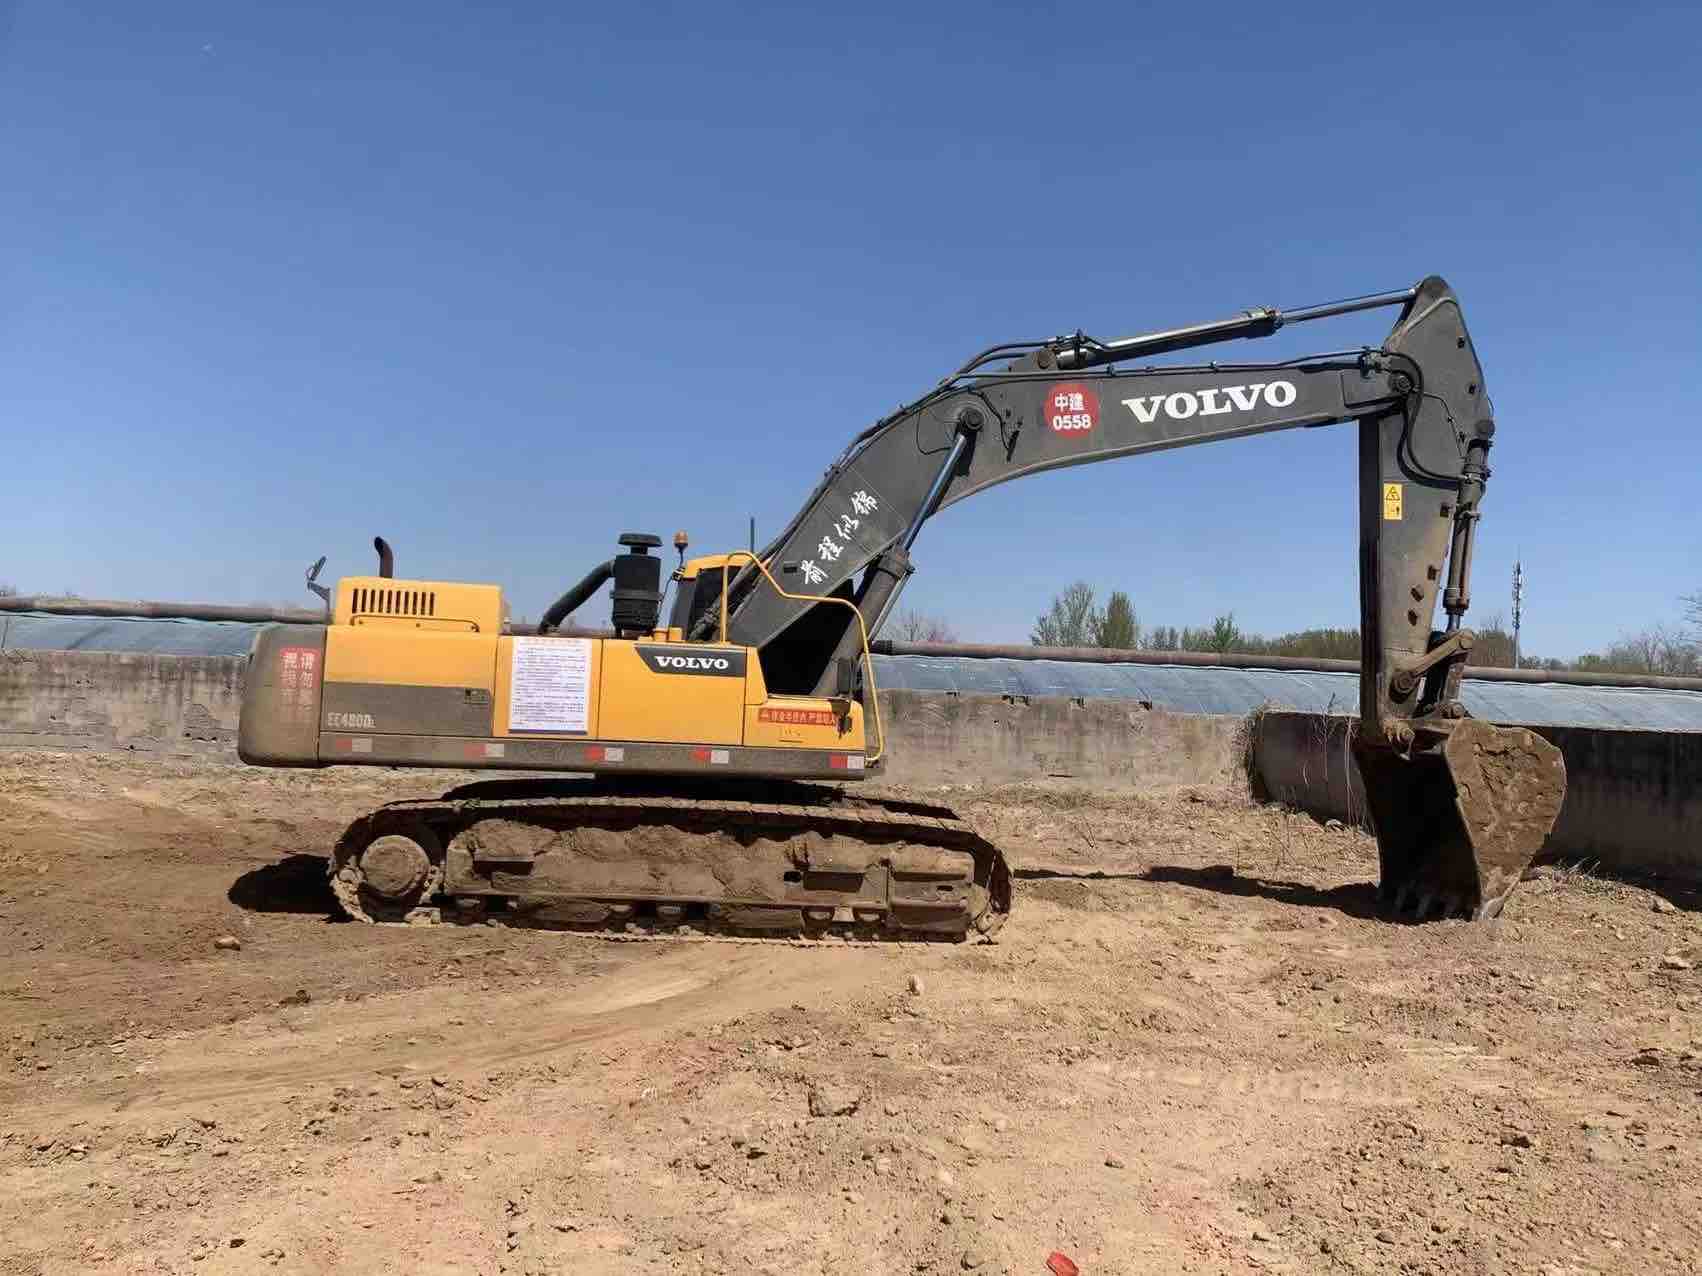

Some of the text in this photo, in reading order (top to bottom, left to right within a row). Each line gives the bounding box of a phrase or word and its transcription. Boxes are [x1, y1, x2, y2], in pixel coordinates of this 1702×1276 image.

[1053, 392, 1086, 412] 中建
[1121, 381, 1297, 424] VOLVO
[1052, 414, 1092, 431] 0558
[654, 656, 729, 671] VOLVO
